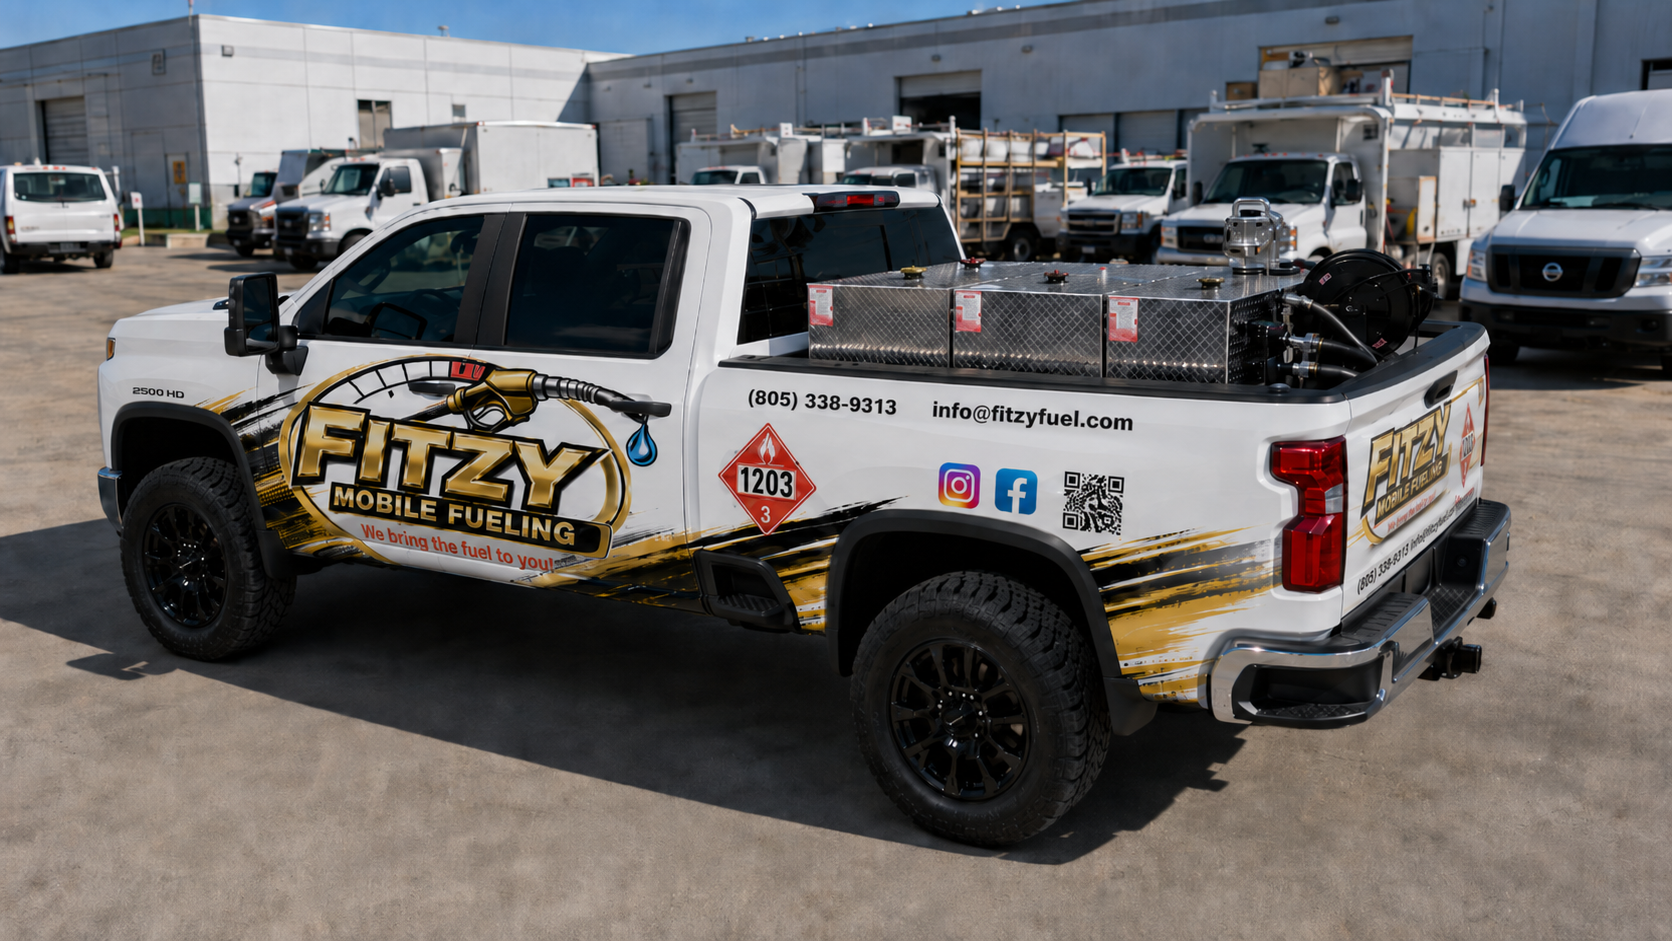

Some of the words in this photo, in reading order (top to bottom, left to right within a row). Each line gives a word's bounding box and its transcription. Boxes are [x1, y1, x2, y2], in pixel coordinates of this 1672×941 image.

[132, 387, 164, 396] 2500
[166, 389, 185, 399] HD
[748, 389, 798, 411] (805)
[804, 393, 897, 415] 338-9313
[932, 401, 1133, 431] info@fitzyfuel.com
[294, 403, 598, 510] FITZY
[1364, 400, 1452, 510] FITZY
[741, 466, 793, 498] 1203
[334, 486, 437, 522] MOBILE
[448, 503, 575, 546] FUELING
[760, 505, 771, 524] 3
[1376, 482, 1411, 519] MOBILE
[361, 523, 384, 541] We
[387, 527, 428, 551] bring
[431, 536, 458, 554] the
[461, 541, 492, 560] fuel
[496, 548, 513, 564] to
[517, 554, 553, 571] you!
